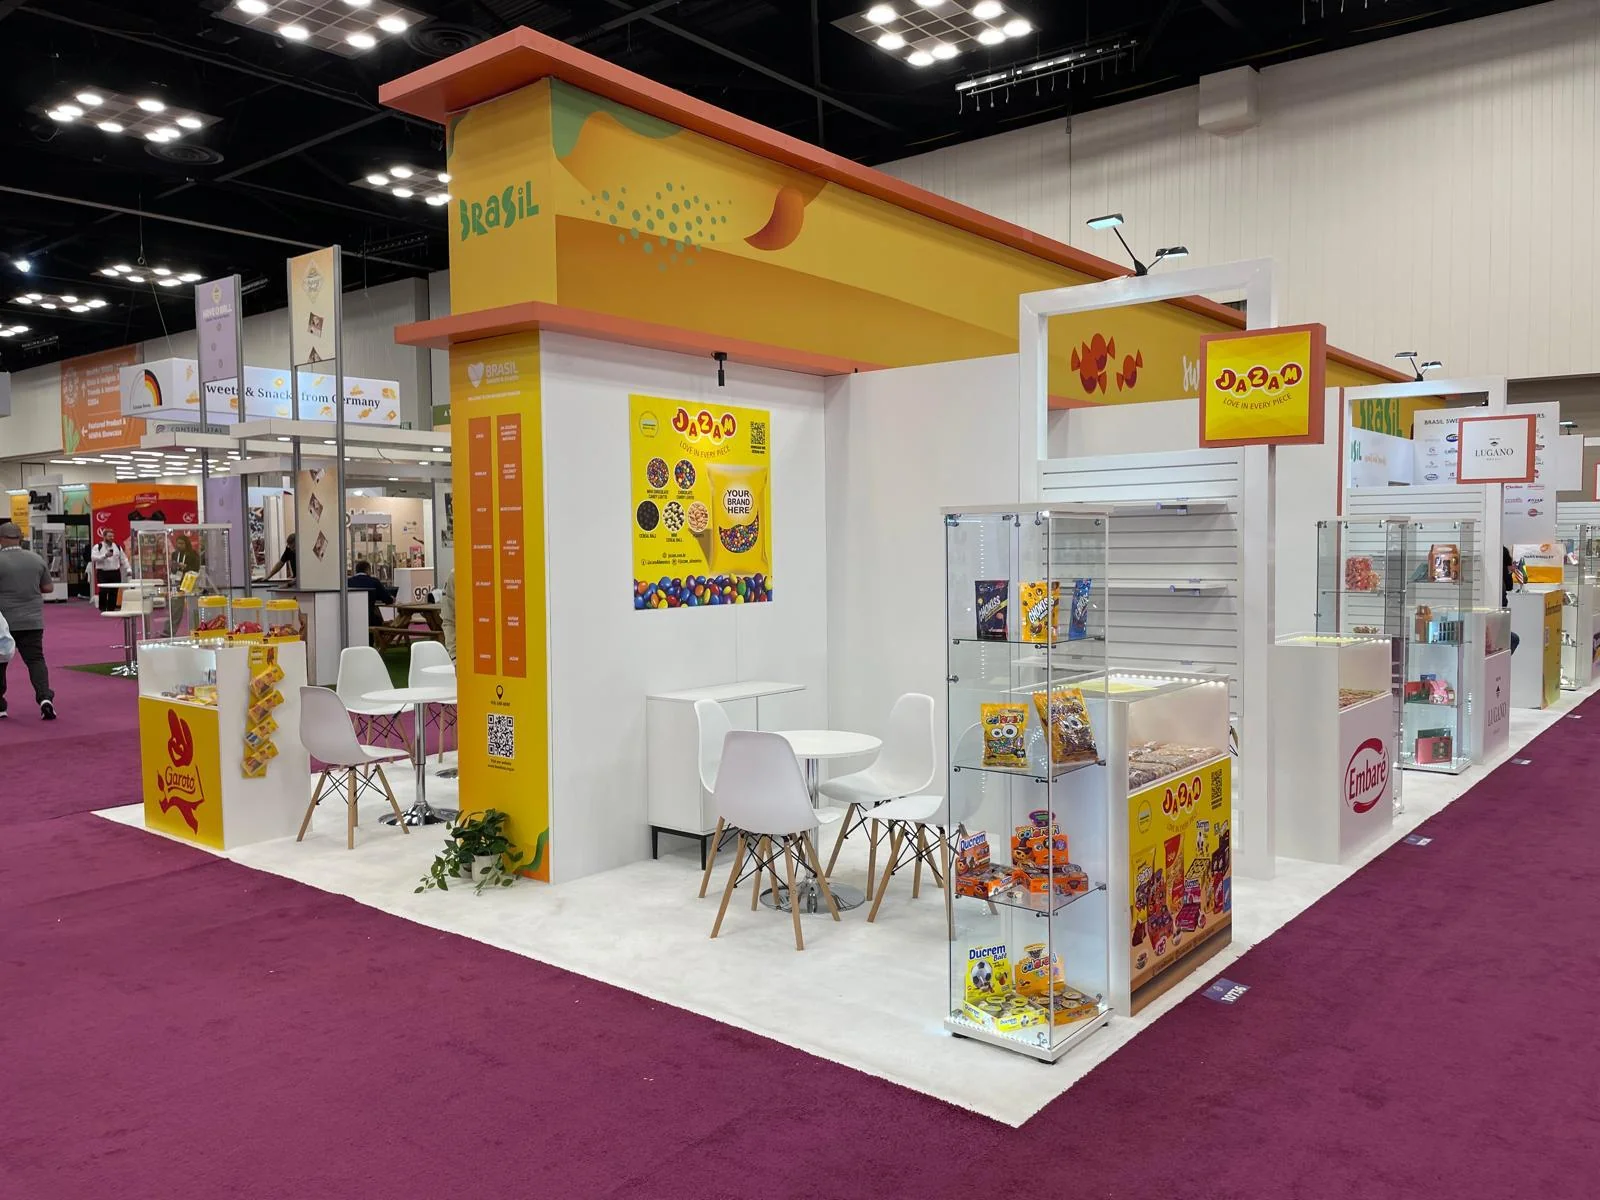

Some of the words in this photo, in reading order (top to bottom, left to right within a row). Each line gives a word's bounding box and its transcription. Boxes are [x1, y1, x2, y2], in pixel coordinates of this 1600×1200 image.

[486, 362, 519, 377] BRASIL
[1215, 363, 1302, 392] JAZAM
[206, 384, 239, 396] weet
[245, 387, 255, 397] &
[258, 388, 292, 400] Snack
[302, 391, 328, 403] from
[1223, 398, 1240, 408] LOVE
[1251, 401, 1270, 410] EVERY
[1273, 393, 1292, 405] PIECE
[170, 426, 223, 434] CONTINTAL
[673, 408, 736, 438] JAZAM
[680, 441, 693, 454] LOVE
[1475, 447, 1514, 457] LUGANO
[727, 489, 750, 498] YOUR
[727, 498, 750, 506] BRAND
[727, 506, 750, 514] HERE
[165, 766, 196, 791] Garoto
[1349, 753, 1386, 801] Embaré
[960, 833, 987, 850] Ducrem
[969, 945, 1006, 960] Ducrem
